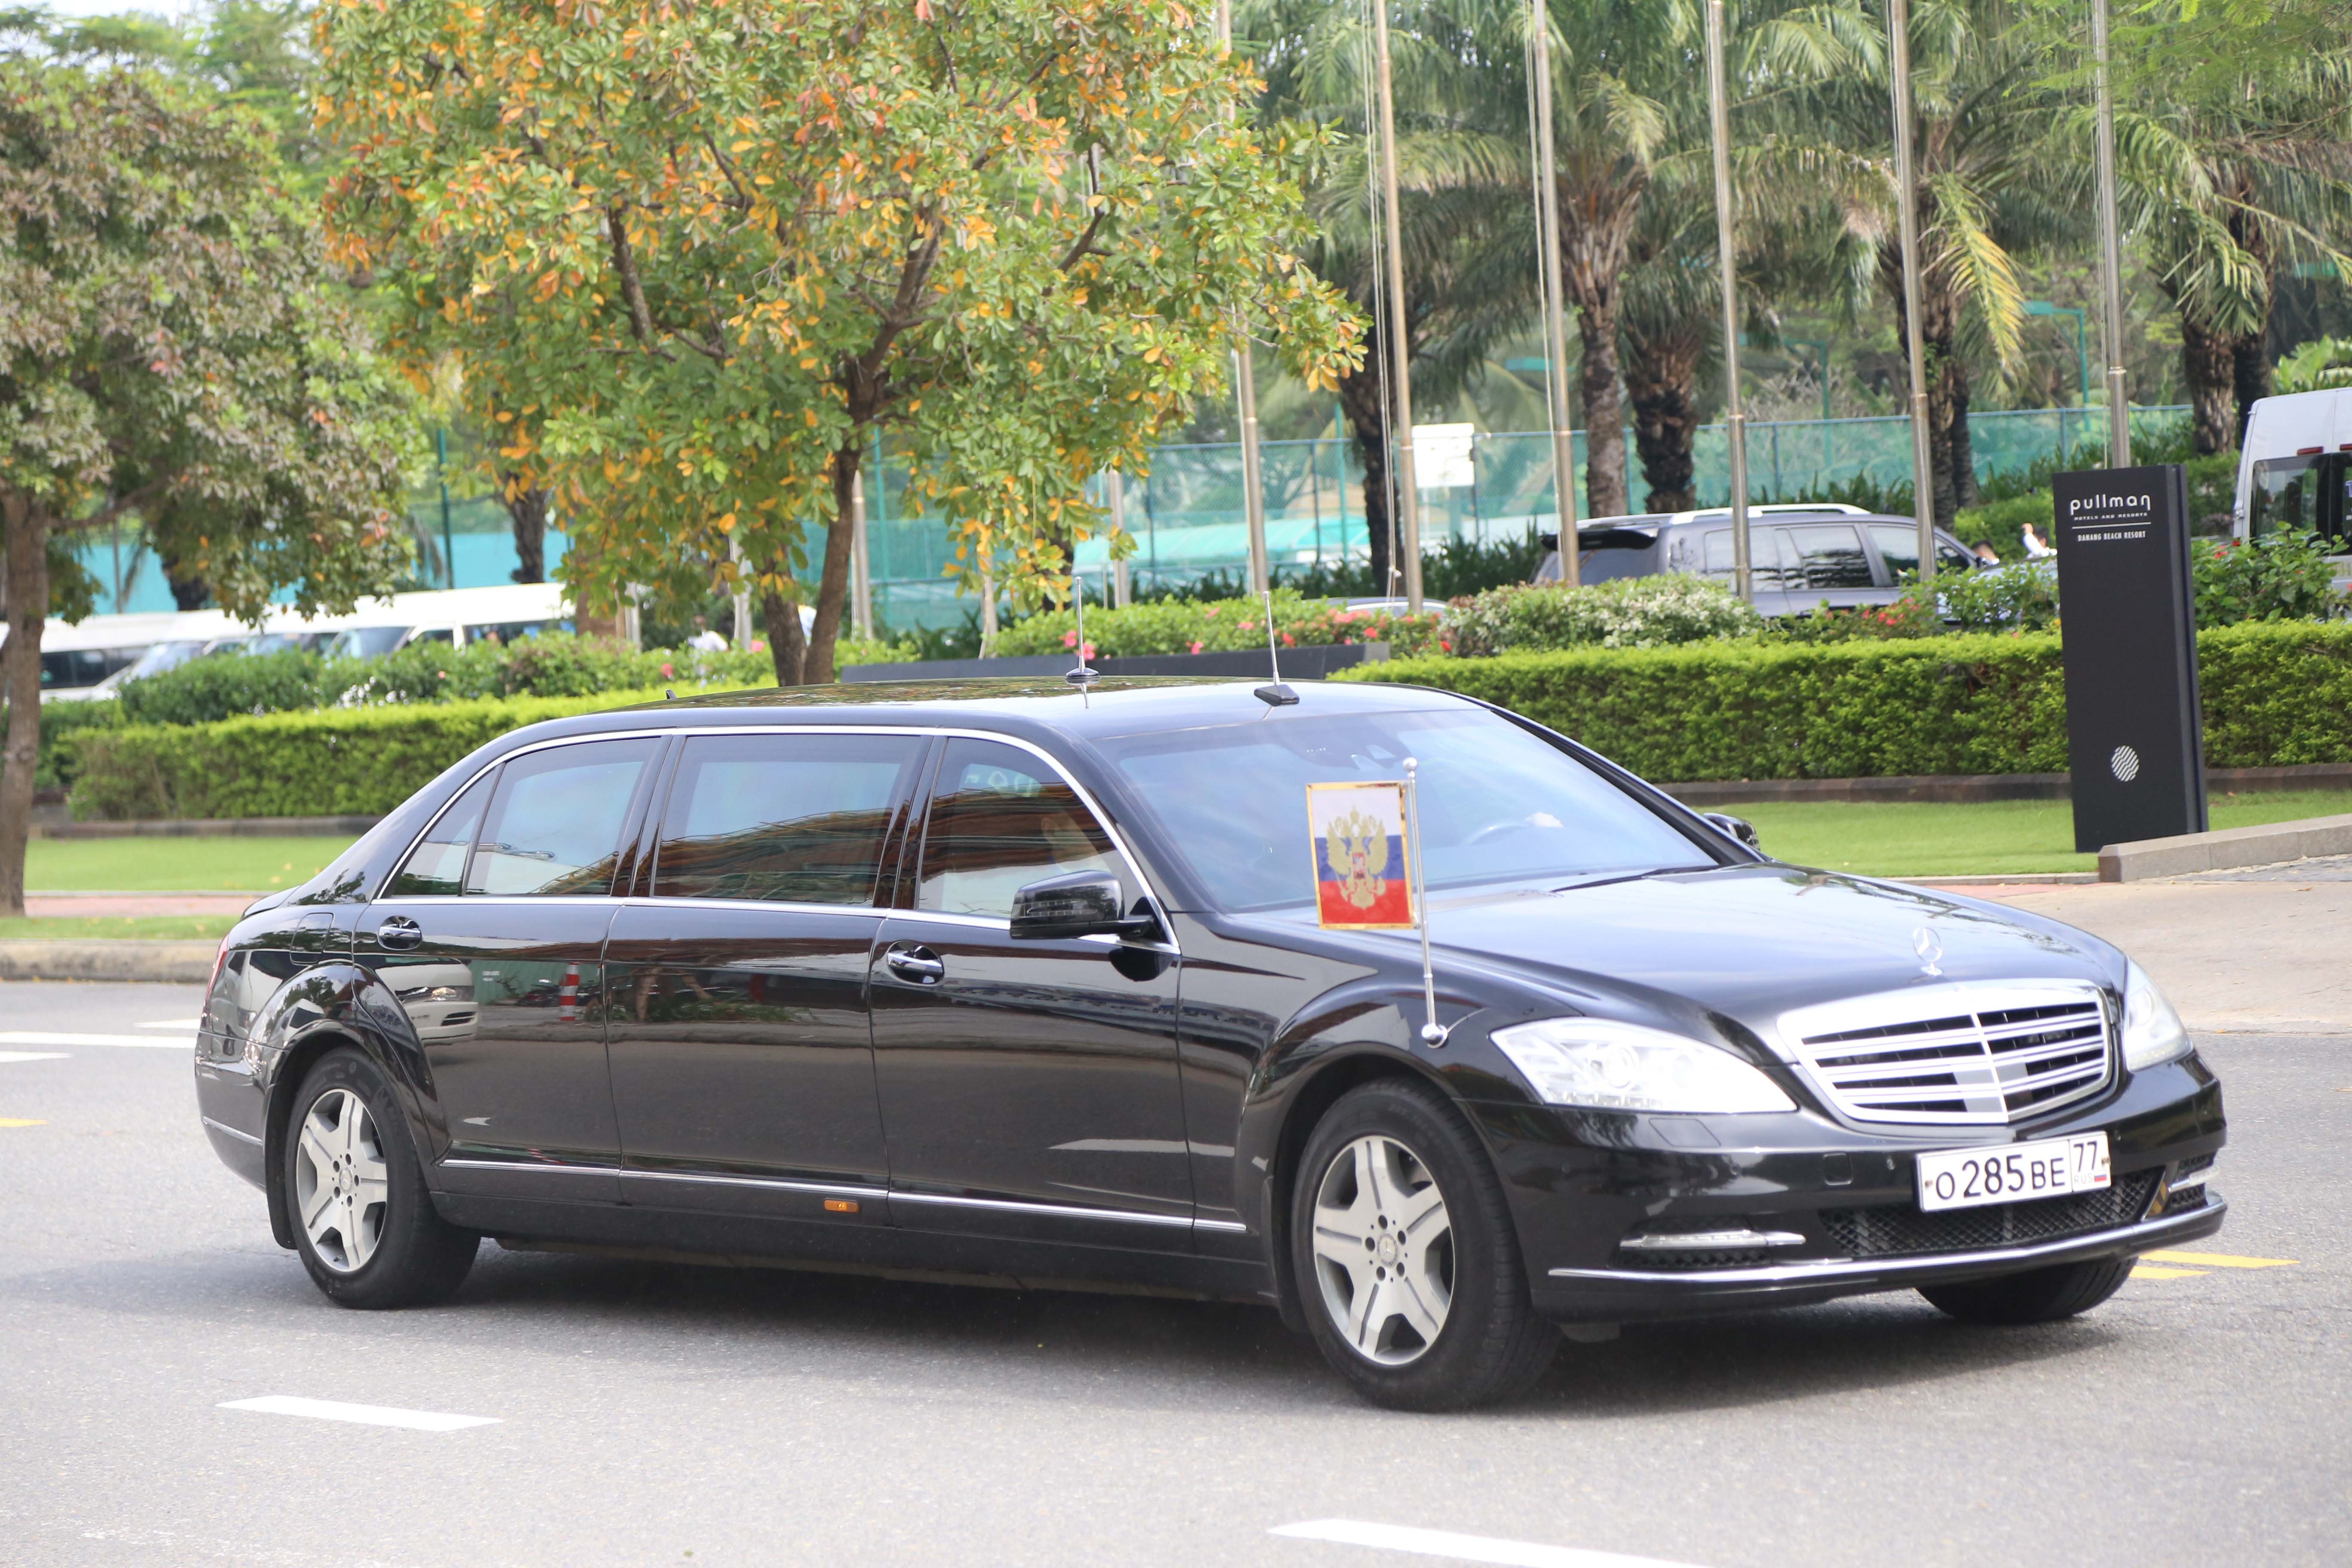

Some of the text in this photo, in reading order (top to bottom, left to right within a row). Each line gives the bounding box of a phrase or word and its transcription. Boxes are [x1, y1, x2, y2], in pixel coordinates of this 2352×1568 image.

[2070, 493, 2151, 516] pullman
[2078, 530, 2146, 542] DANANG BEACH RESORT
[2073, 1140, 2097, 1173] 77
[2074, 1173, 2093, 1185] RUS
